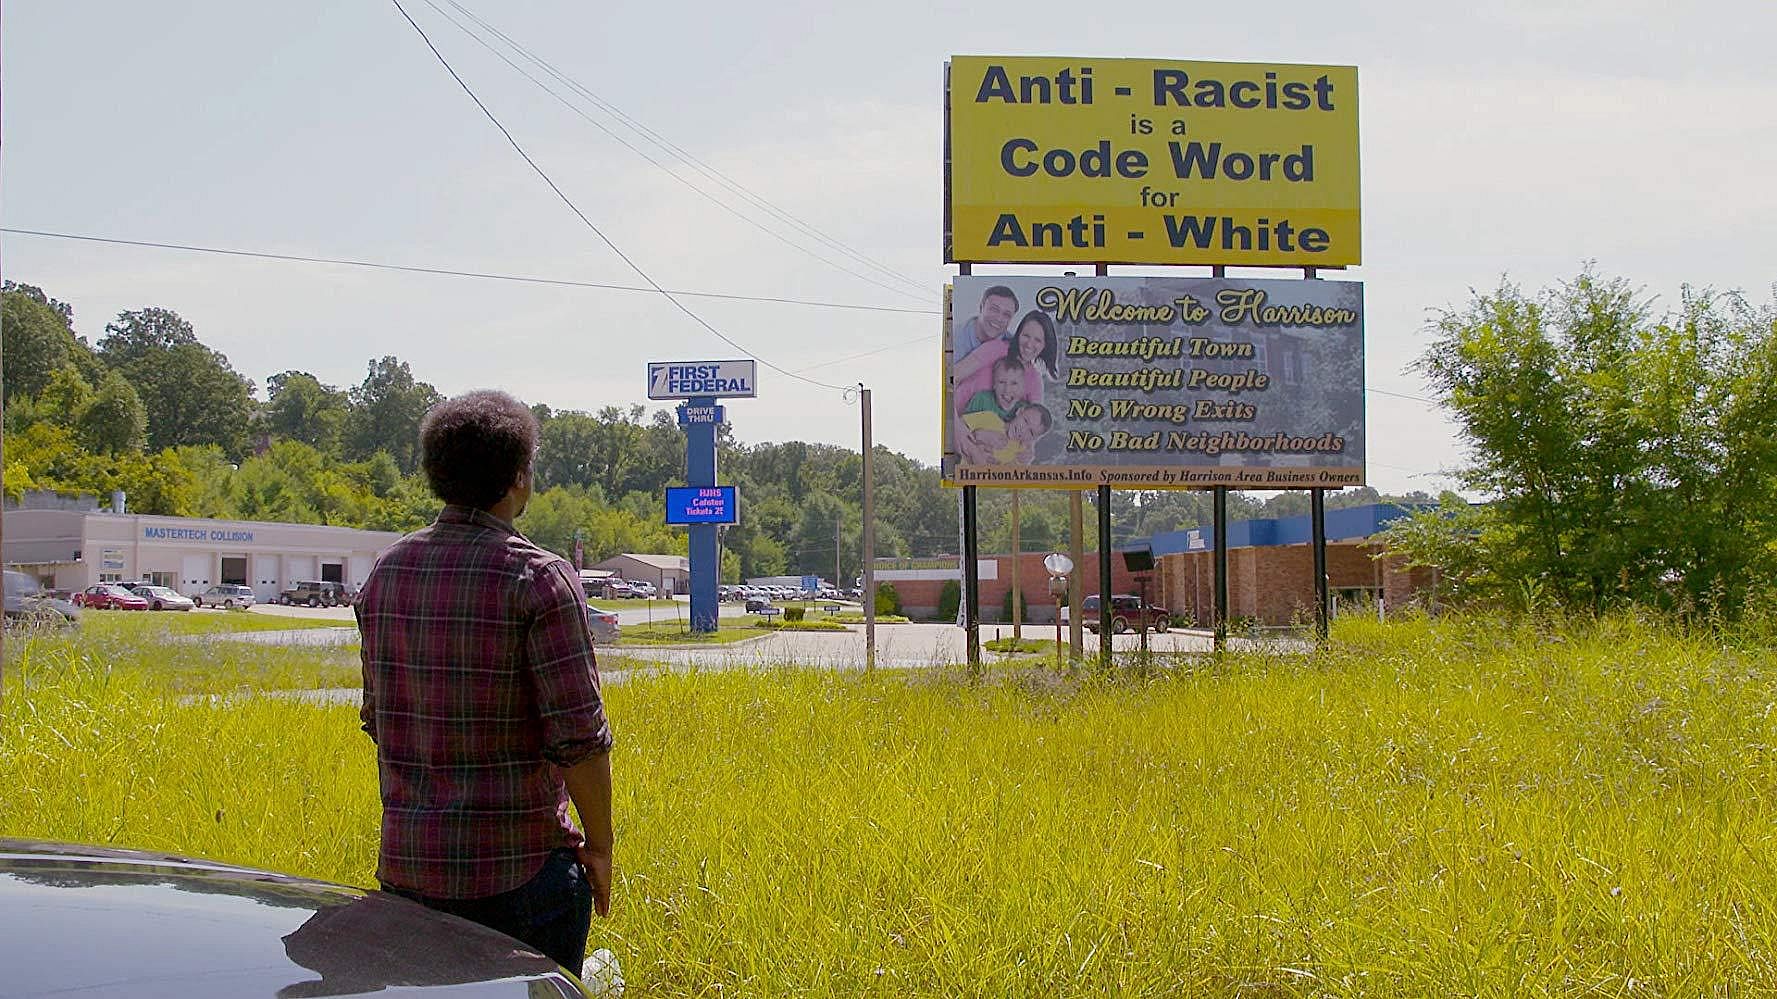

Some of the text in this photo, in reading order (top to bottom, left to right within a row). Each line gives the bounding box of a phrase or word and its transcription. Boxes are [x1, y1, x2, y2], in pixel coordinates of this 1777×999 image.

[976, 65, 1094, 105] Anti
[1153, 69, 1336, 111] Racist
[1131, 113, 1186, 136] is a
[1000, 138, 1314, 182] Code Word
[1140, 186, 1180, 208] for
[987, 213, 1106, 248] Anti
[1163, 214, 1331, 253] White
[1037, 287, 1357, 325] Welcome to Harrison
[1068, 336, 1252, 360] Beautiful Town
[669, 365, 720, 380] FIRST
[1068, 368, 1267, 392] Beautiful People
[669, 378, 751, 393] FEDERAL
[687, 407, 715, 416] DRIVE
[688, 415, 714, 423] THRU
[1068, 399, 1255, 422] No Wrong Exits
[1068, 431, 1344, 455] No Bad Neighborhoods
[960, 469, 1360, 484] HarrisonArkansas.Info Sponsored by Harrison Area Business Owners
[145, 527, 254, 542] MASTERTECH COLLISION
